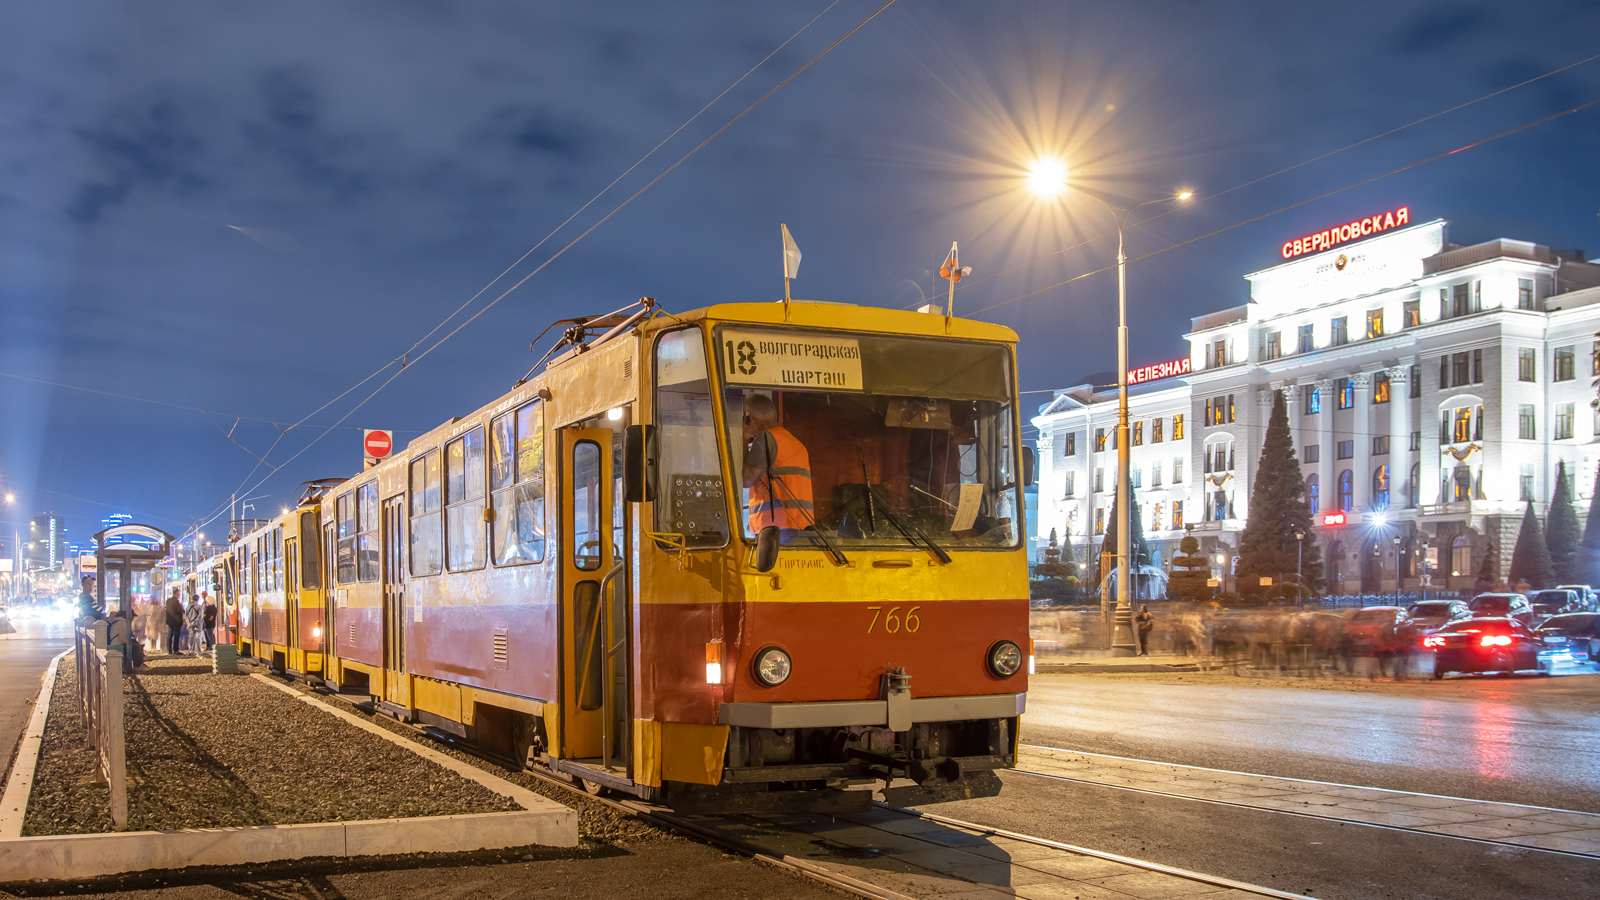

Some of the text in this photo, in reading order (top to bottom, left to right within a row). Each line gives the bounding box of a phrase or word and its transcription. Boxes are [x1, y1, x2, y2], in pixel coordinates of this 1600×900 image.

[1282, 207, 1409, 258] СВЕРДЛОВСКАЯ
[725, 340, 757, 375] 18
[1127, 358, 1191, 384] ЖЕЛЕЗНАЯ
[867, 605, 921, 634] 766
